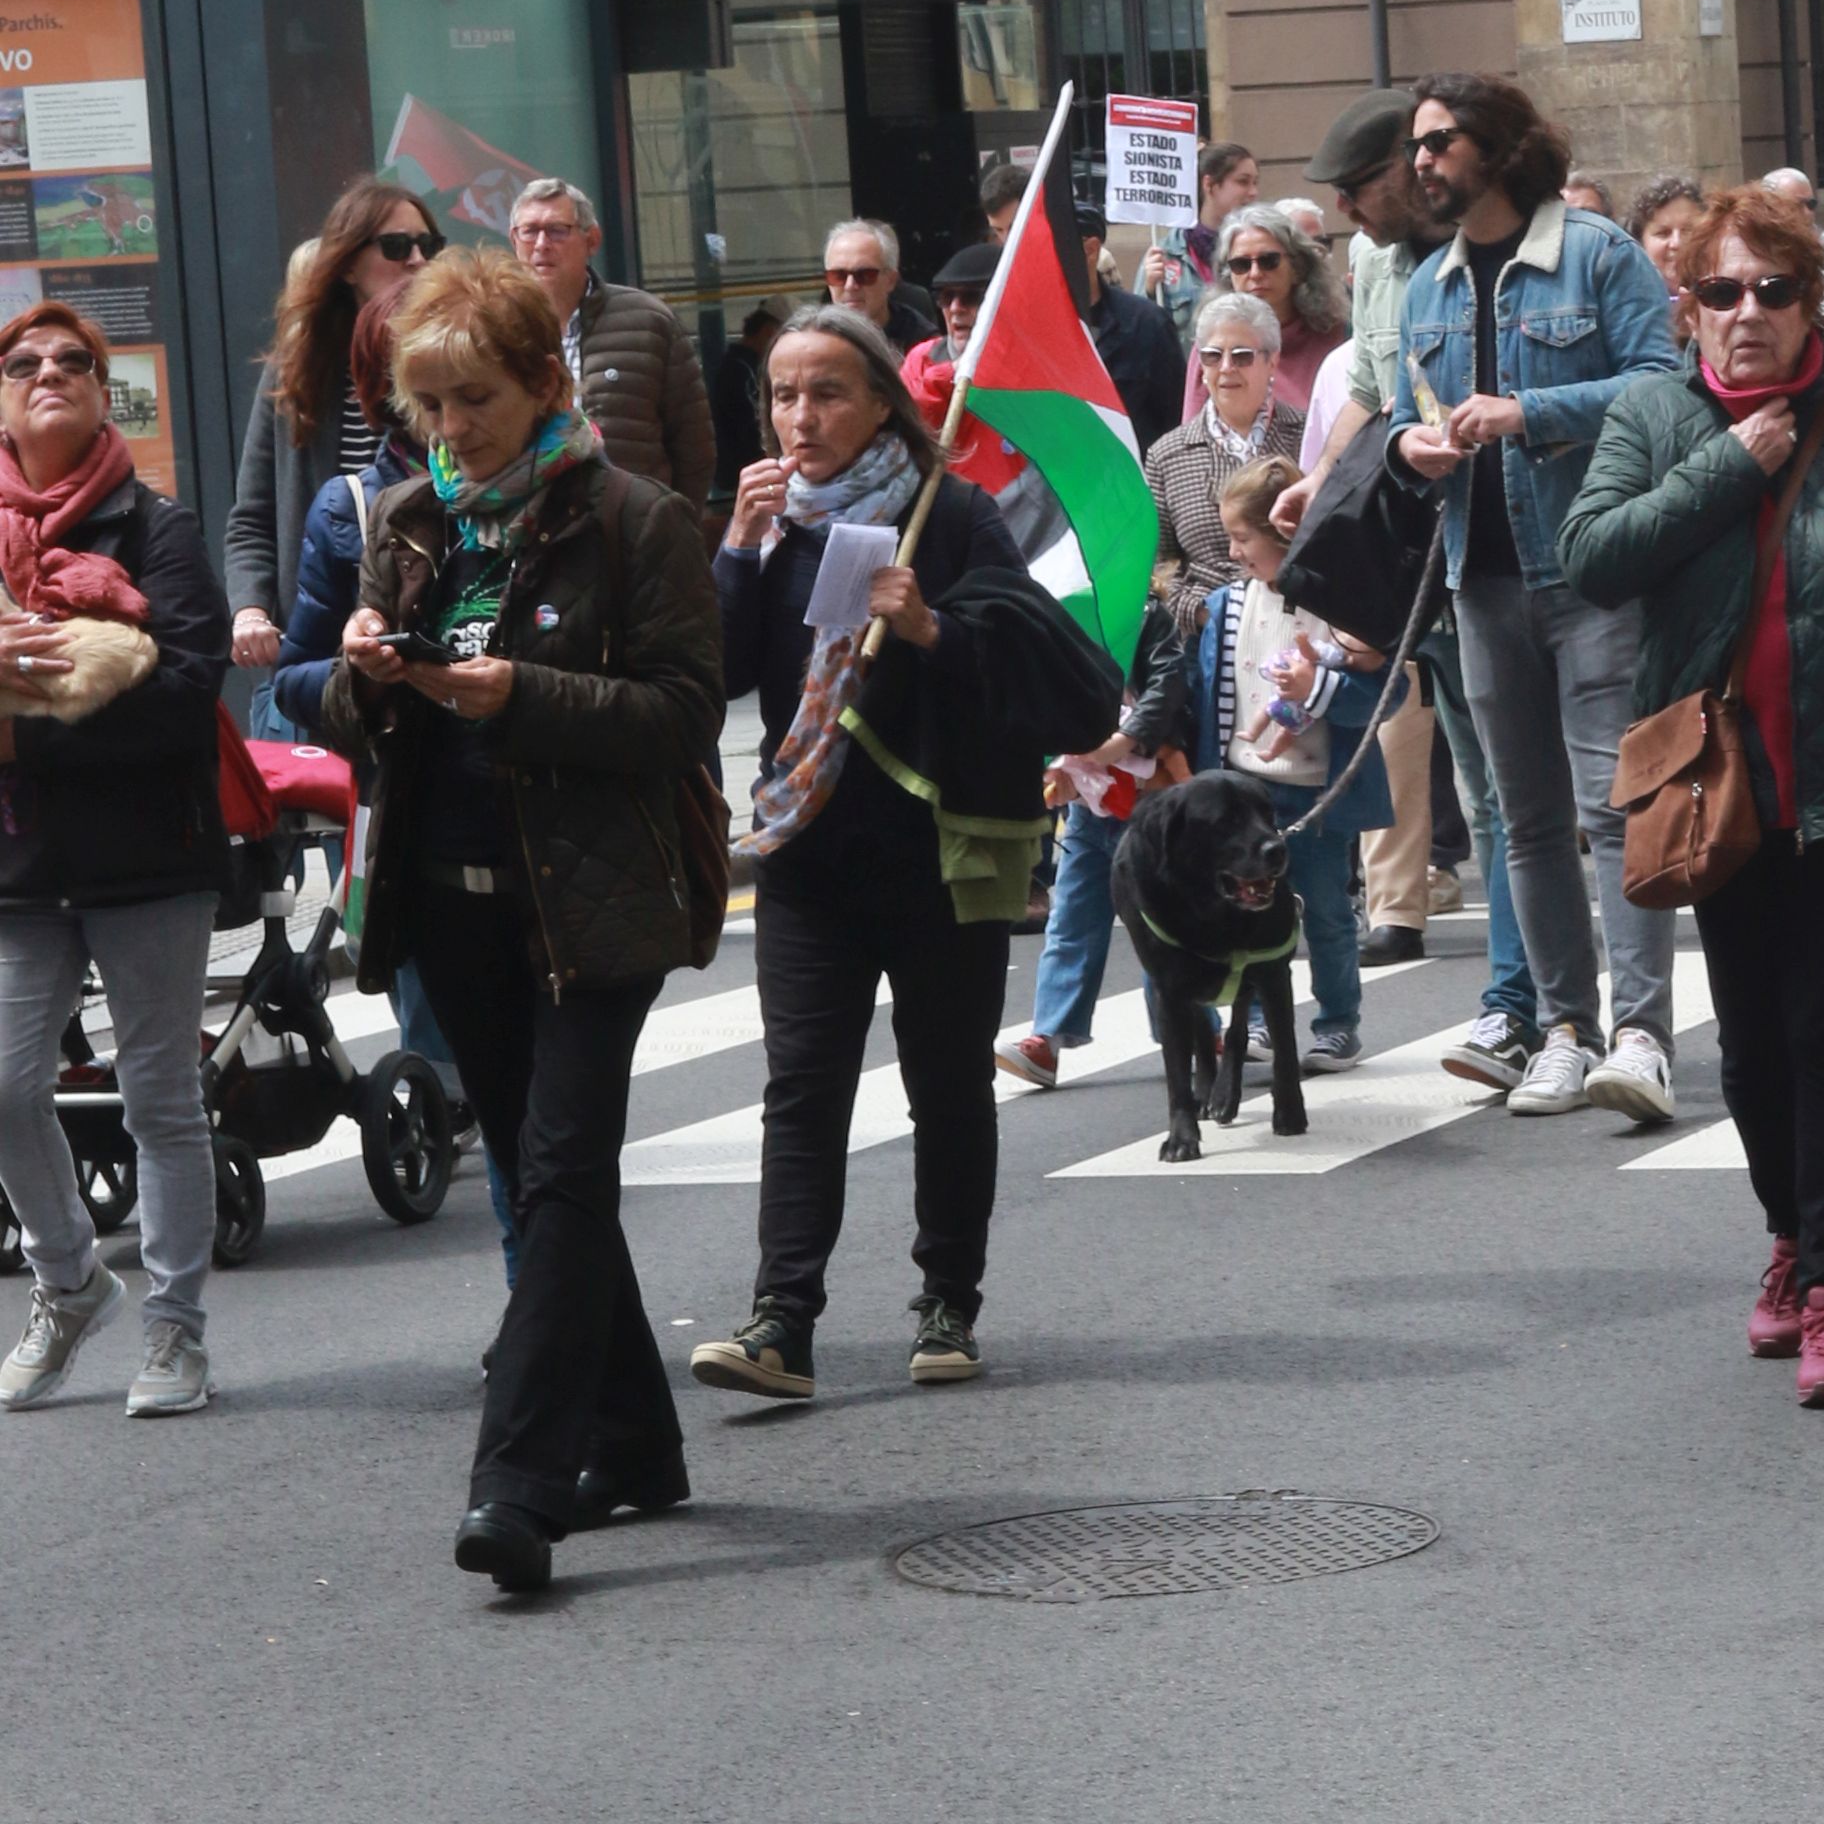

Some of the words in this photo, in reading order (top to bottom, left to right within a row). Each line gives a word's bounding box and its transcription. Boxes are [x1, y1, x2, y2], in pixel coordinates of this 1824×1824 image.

[1575, 10, 1635, 27] INSTITUTO
[1130, 133, 1177, 151] ESTADO
[1124, 151, 1183, 171] SIONISTA
[1130, 170, 1177, 189] ESTADO
[1115, 188, 1192, 208] TERRORISTA
